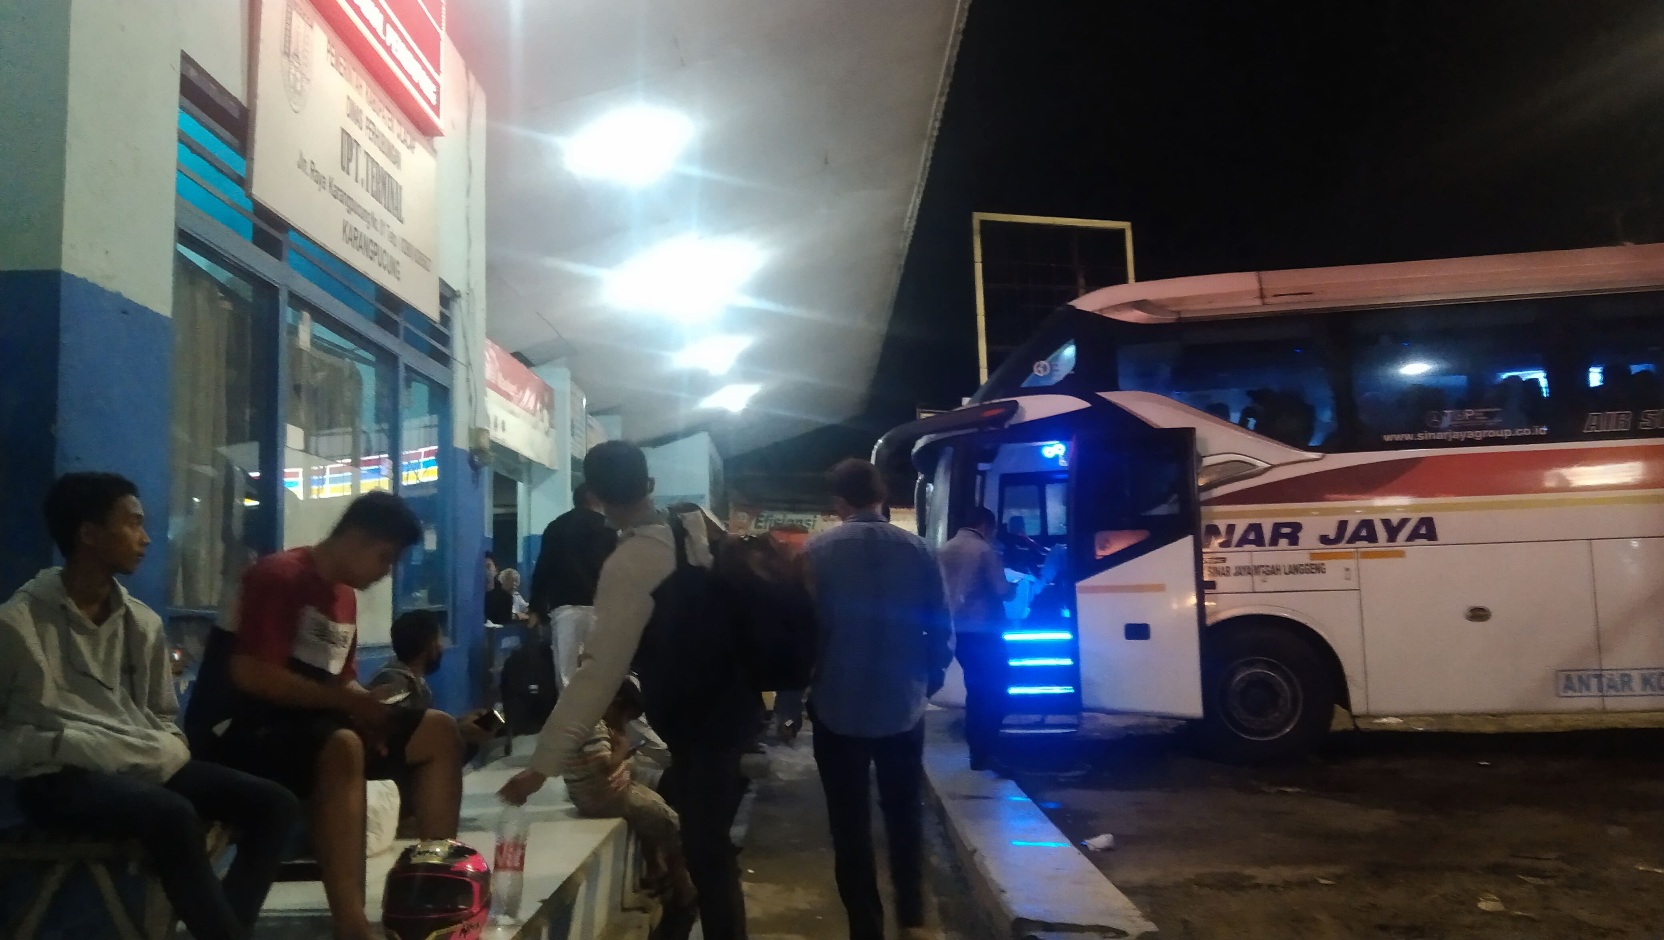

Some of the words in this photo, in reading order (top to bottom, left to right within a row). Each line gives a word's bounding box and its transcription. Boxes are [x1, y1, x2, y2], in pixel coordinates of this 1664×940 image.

[1583, 410, 1632, 433] AIR
[1382, 426, 1548, 442] www.sinarjayagroup.co.id
[1318, 516, 1438, 546] JAYA
[1283, 561, 1327, 575] LANGGENG
[1562, 672, 1635, 694] ANTAR
